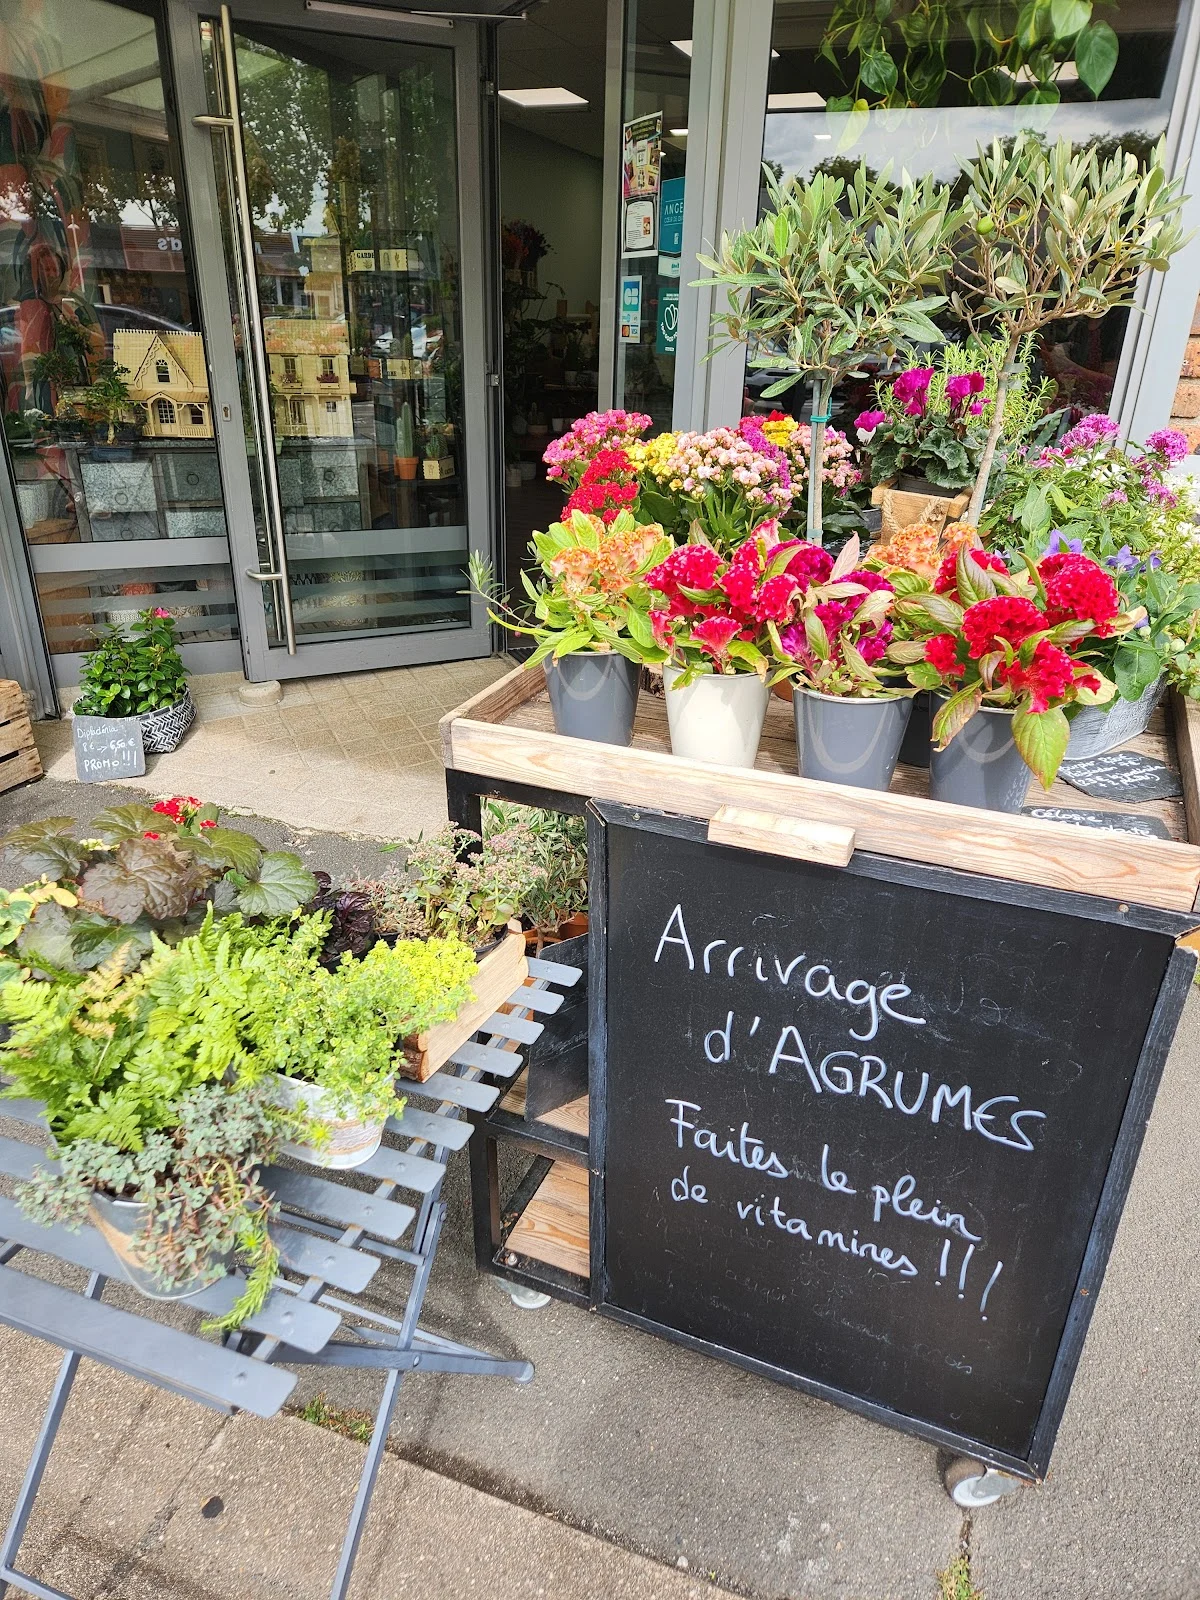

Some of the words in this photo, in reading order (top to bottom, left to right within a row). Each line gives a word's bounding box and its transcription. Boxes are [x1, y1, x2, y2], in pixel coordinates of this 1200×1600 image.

[654, 903, 927, 1041] Arrivage
[665, 1098, 789, 1178] Faites
[822, 1144, 857, 1194] le
[871, 1174, 982, 1242] plein
[671, 1166, 708, 1204] de
[736, 1194, 919, 1276] vitamines
